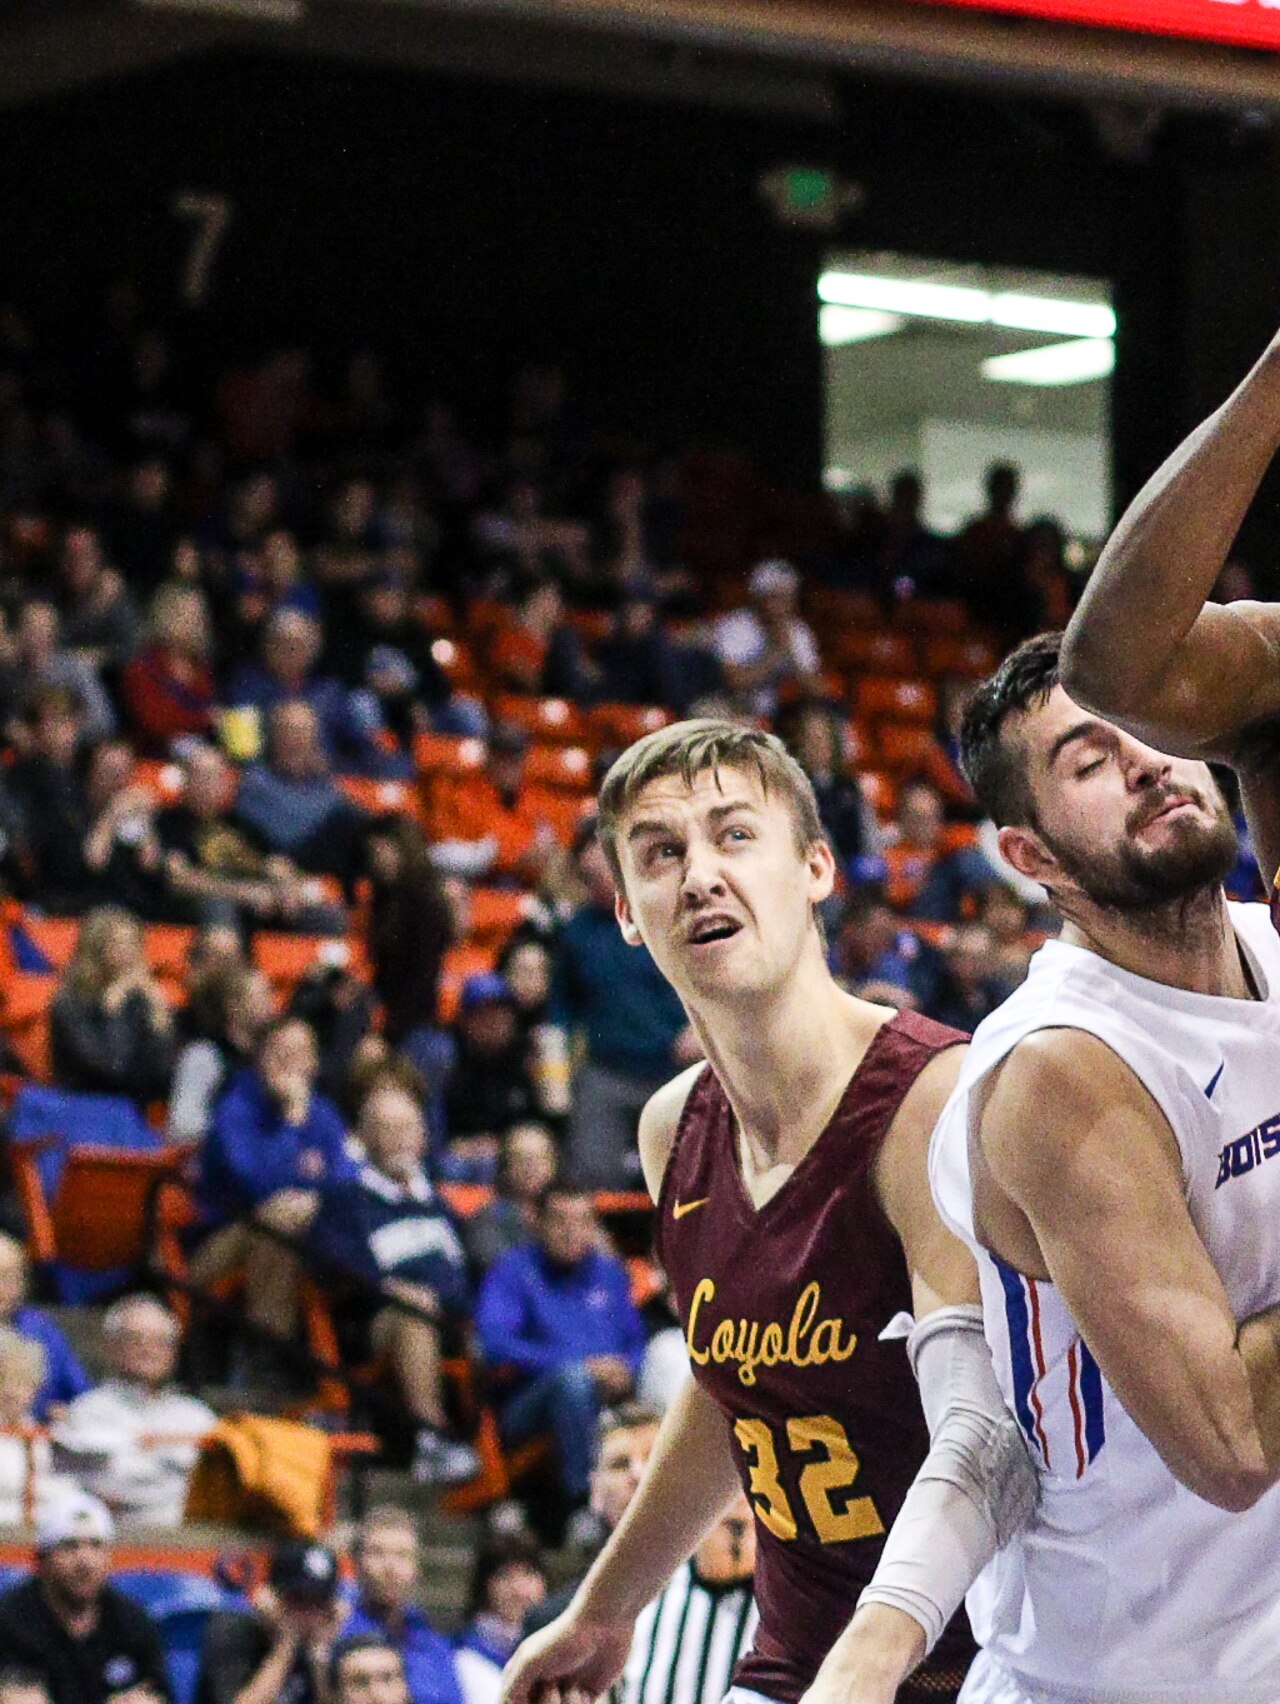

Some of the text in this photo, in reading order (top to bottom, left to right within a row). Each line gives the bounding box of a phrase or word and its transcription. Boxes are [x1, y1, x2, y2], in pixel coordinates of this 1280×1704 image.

[176, 194, 228, 300] 7
[687, 1278, 858, 1386] Loyola
[734, 1414, 886, 1544] 32
